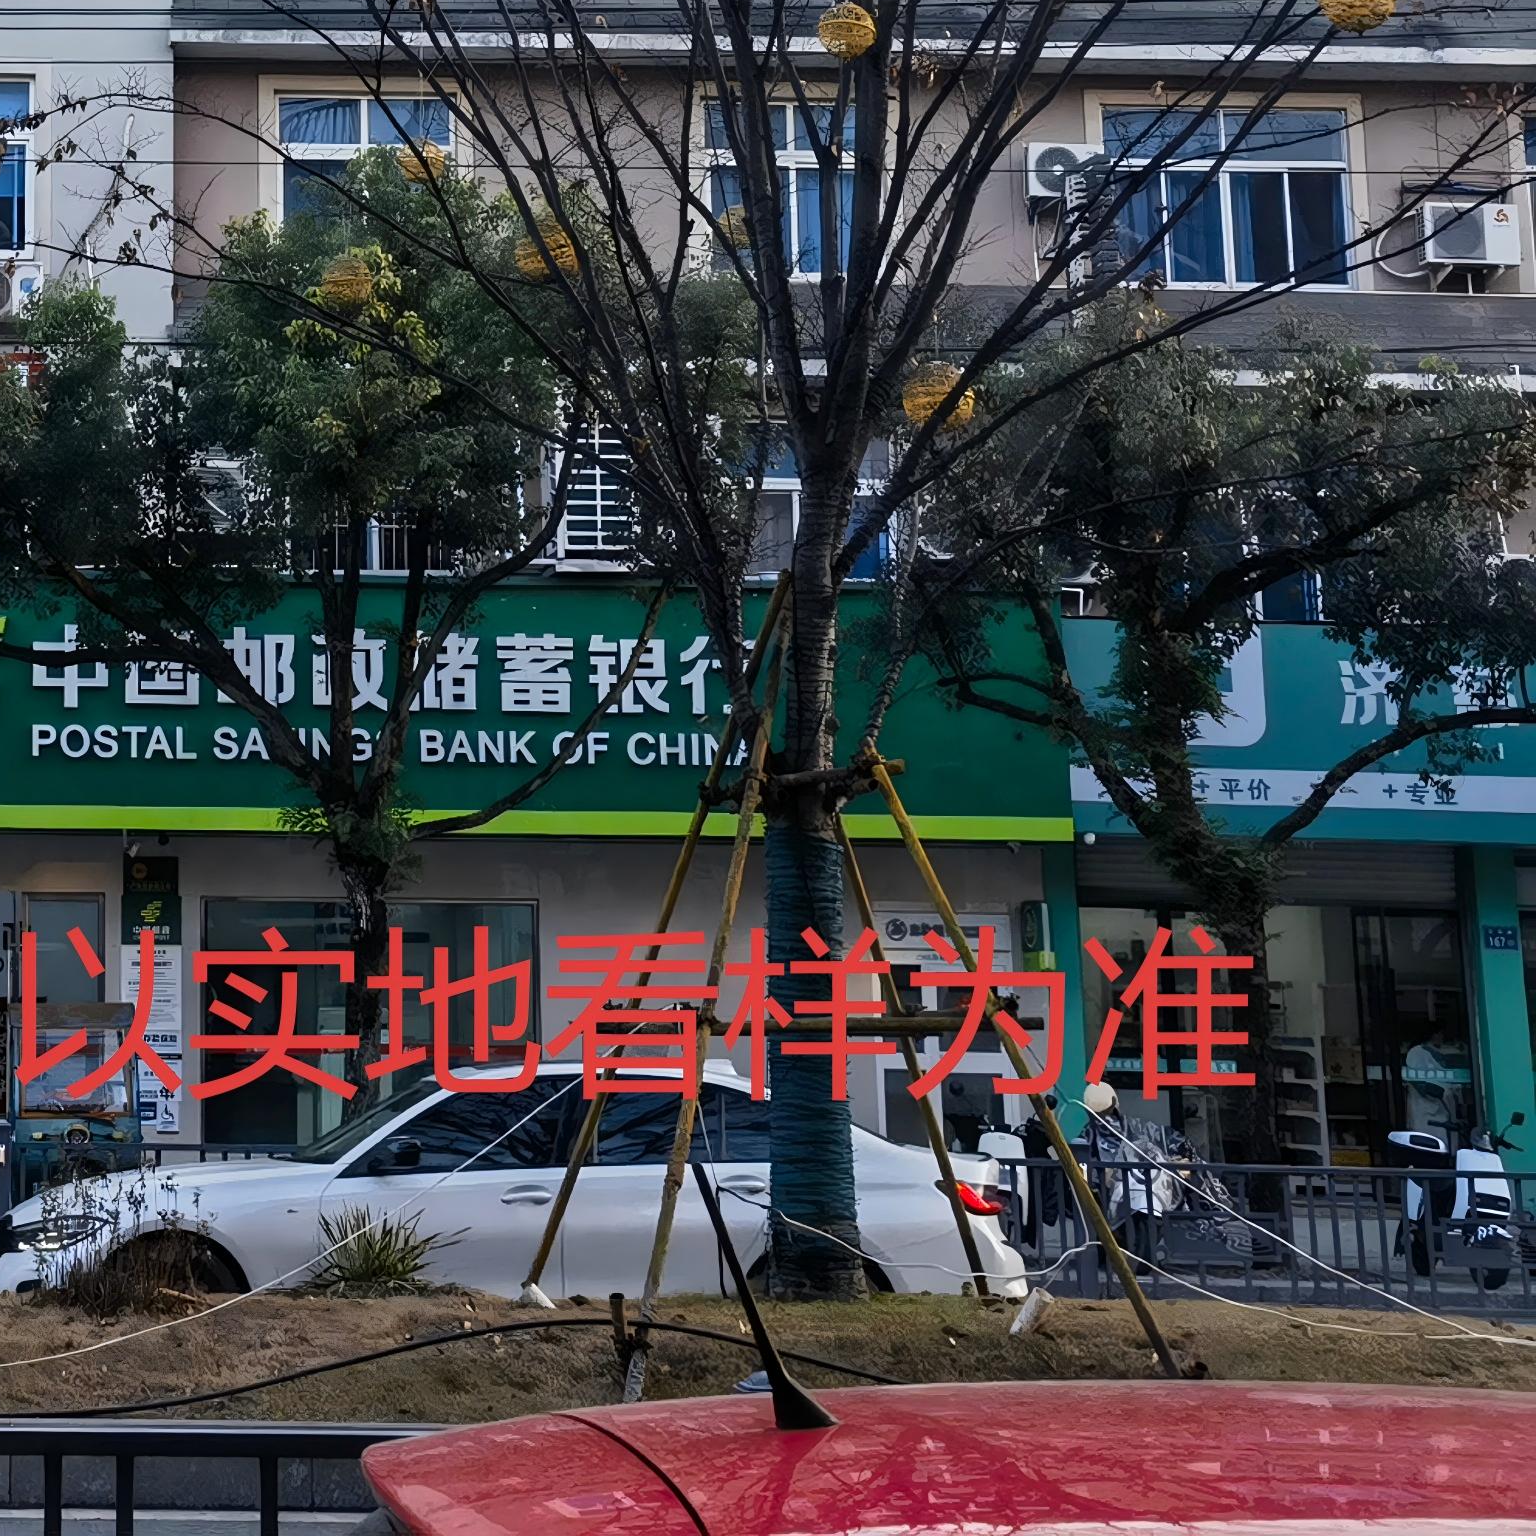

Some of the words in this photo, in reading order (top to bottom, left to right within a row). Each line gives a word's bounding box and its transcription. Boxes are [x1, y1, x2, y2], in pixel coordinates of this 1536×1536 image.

[32, 723, 197, 761] POSTAL
[213, 725, 382, 762] SAING
[420, 728, 537, 764] BANK
[552, 730, 610, 765] OF
[1218, 778, 1271, 801] 平价
